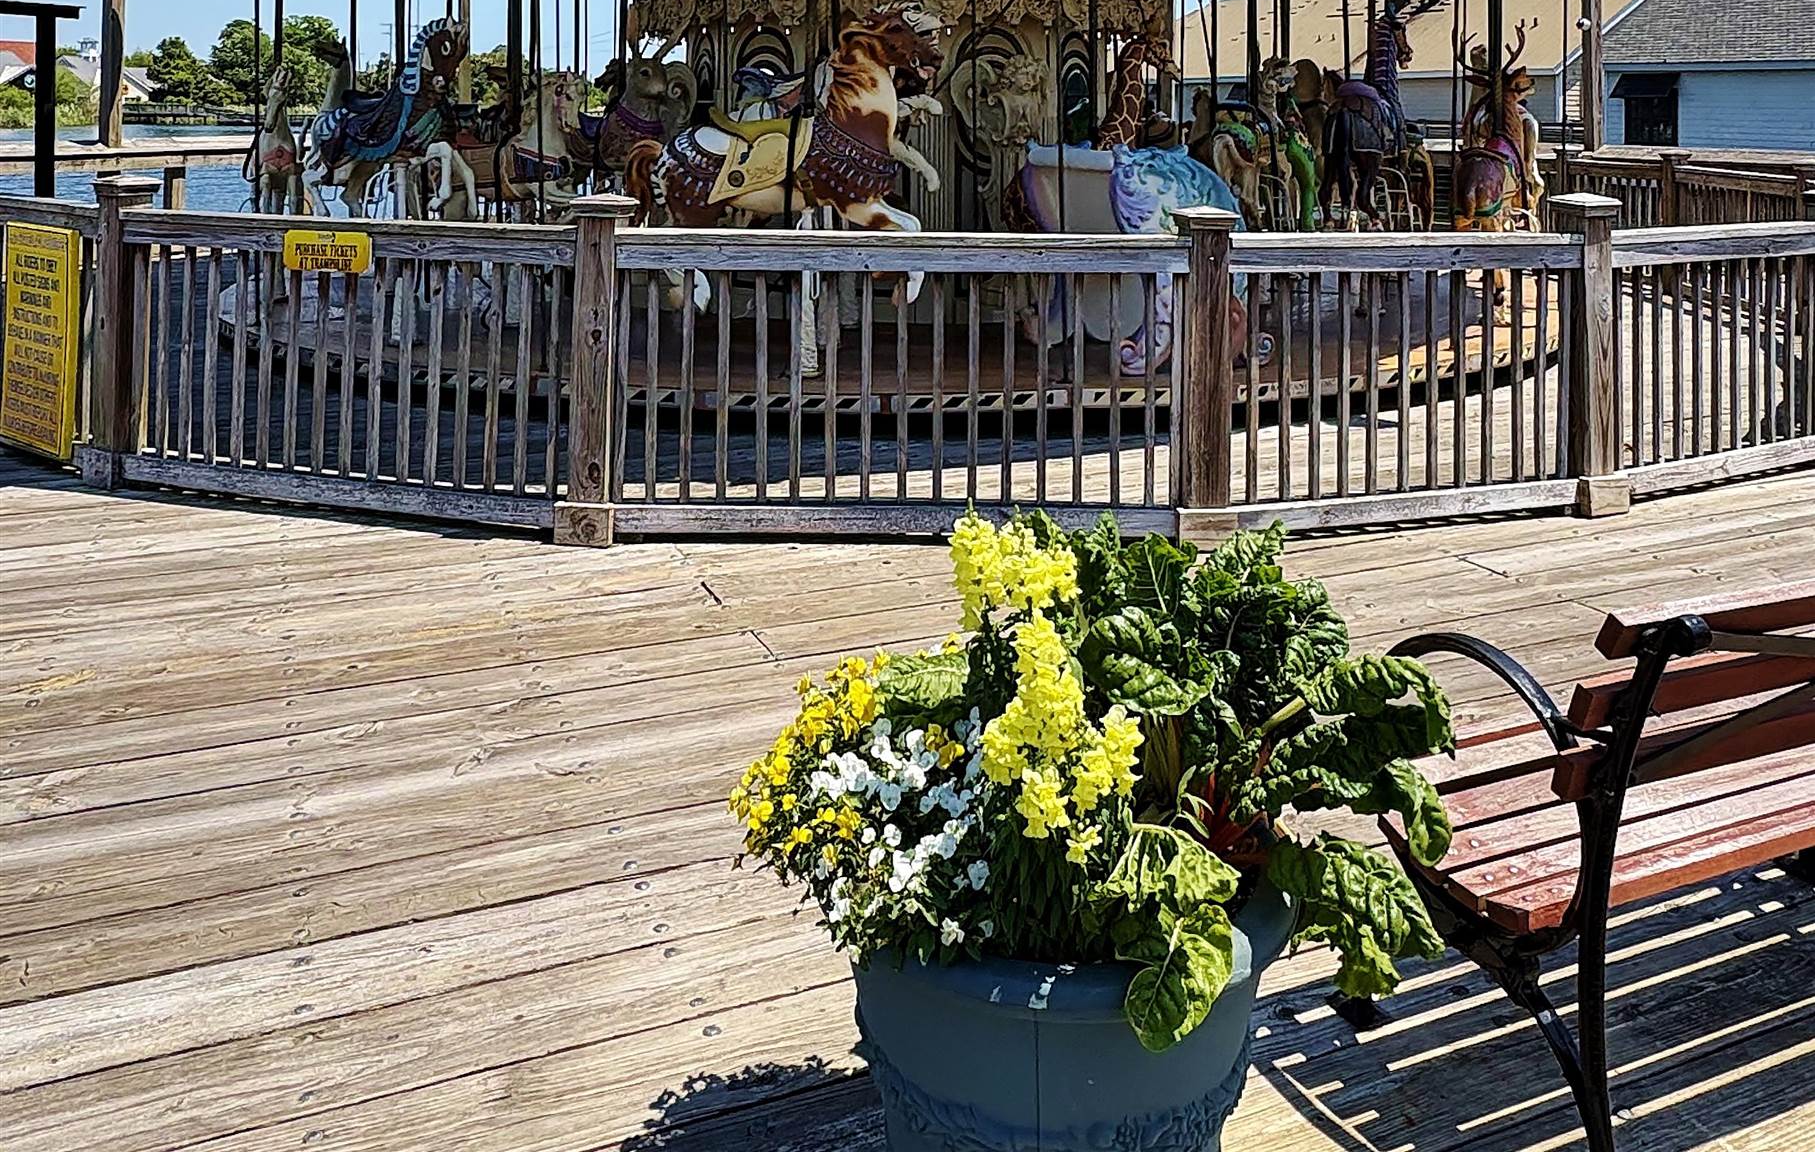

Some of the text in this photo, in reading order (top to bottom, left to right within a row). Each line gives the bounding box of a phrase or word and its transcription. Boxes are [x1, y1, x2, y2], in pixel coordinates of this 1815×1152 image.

[295, 243, 358, 258] PURCHASE TICKETS
[299, 257, 353, 271] AT TRAMPOLINE
